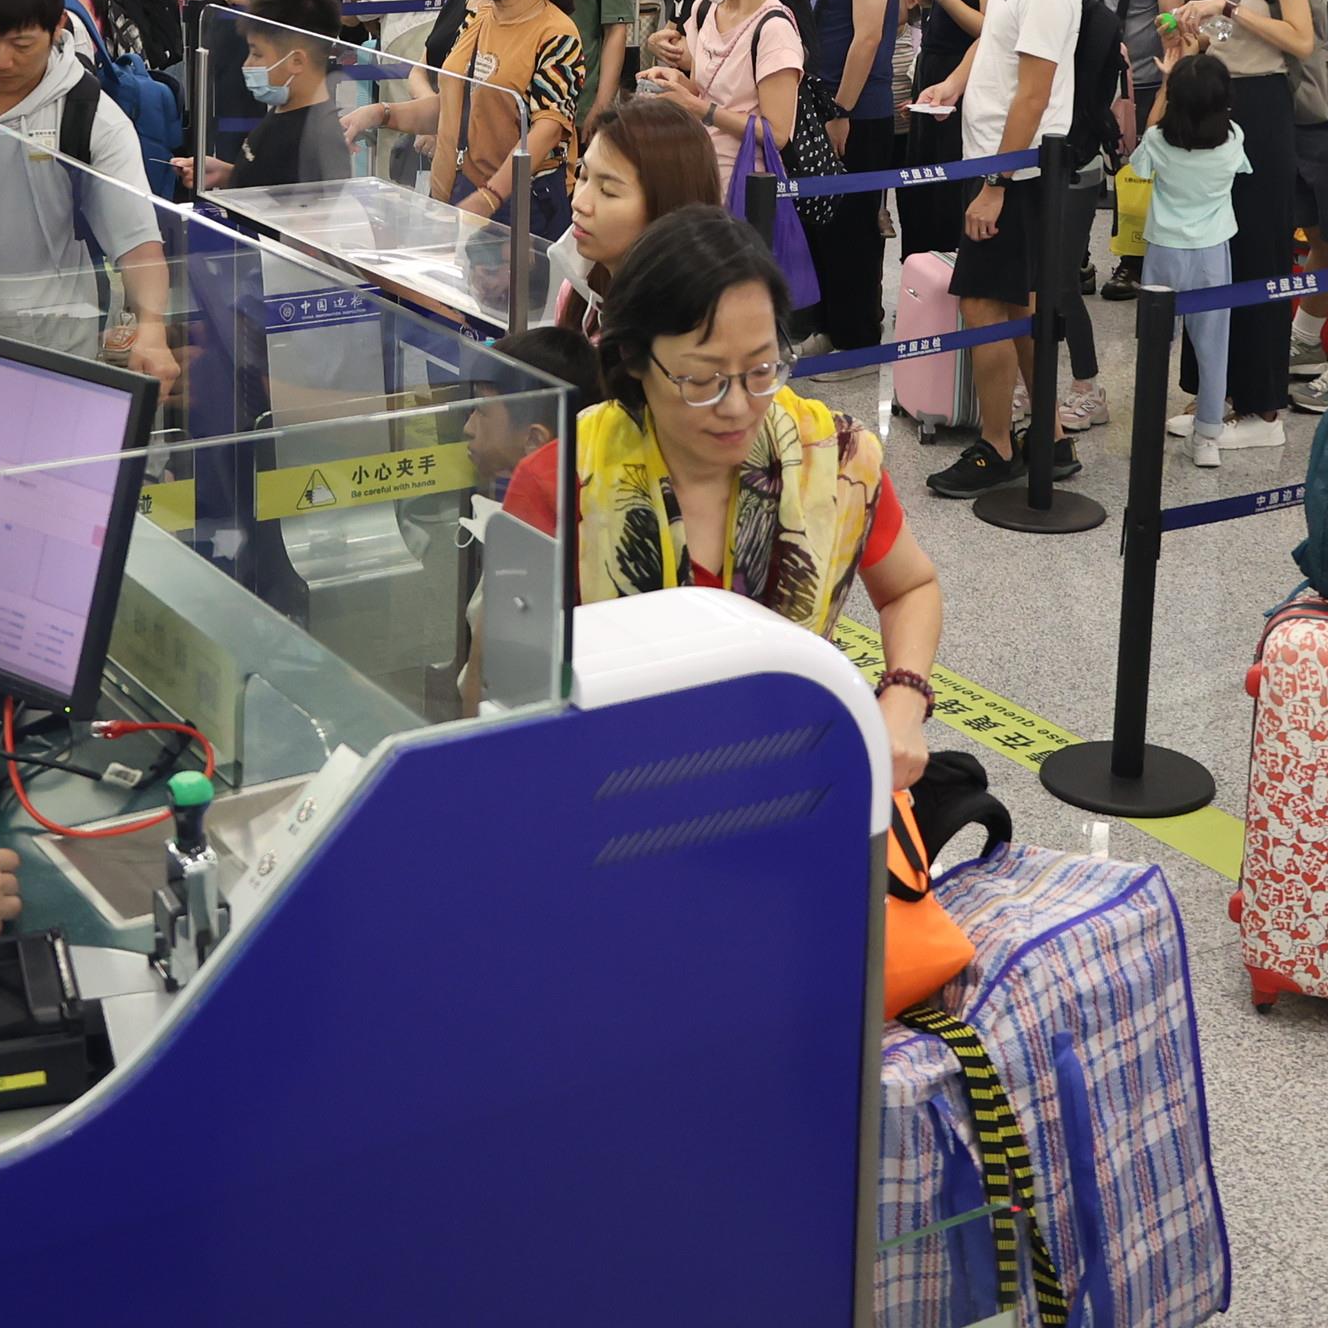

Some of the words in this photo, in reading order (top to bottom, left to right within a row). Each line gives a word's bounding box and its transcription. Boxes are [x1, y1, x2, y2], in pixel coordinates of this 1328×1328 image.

[900, 166, 945, 180] 中国边检
[897, 337, 941, 354] 中国边检
[352, 455, 436, 485] 小心夹手
[351, 489, 362, 498] Be
[363, 485, 392, 496] careful
[393, 482, 411, 493] with
[412, 478, 436, 490] hands
[985, 701, 1036, 728] queue
[1036, 729, 1070, 747] ase
